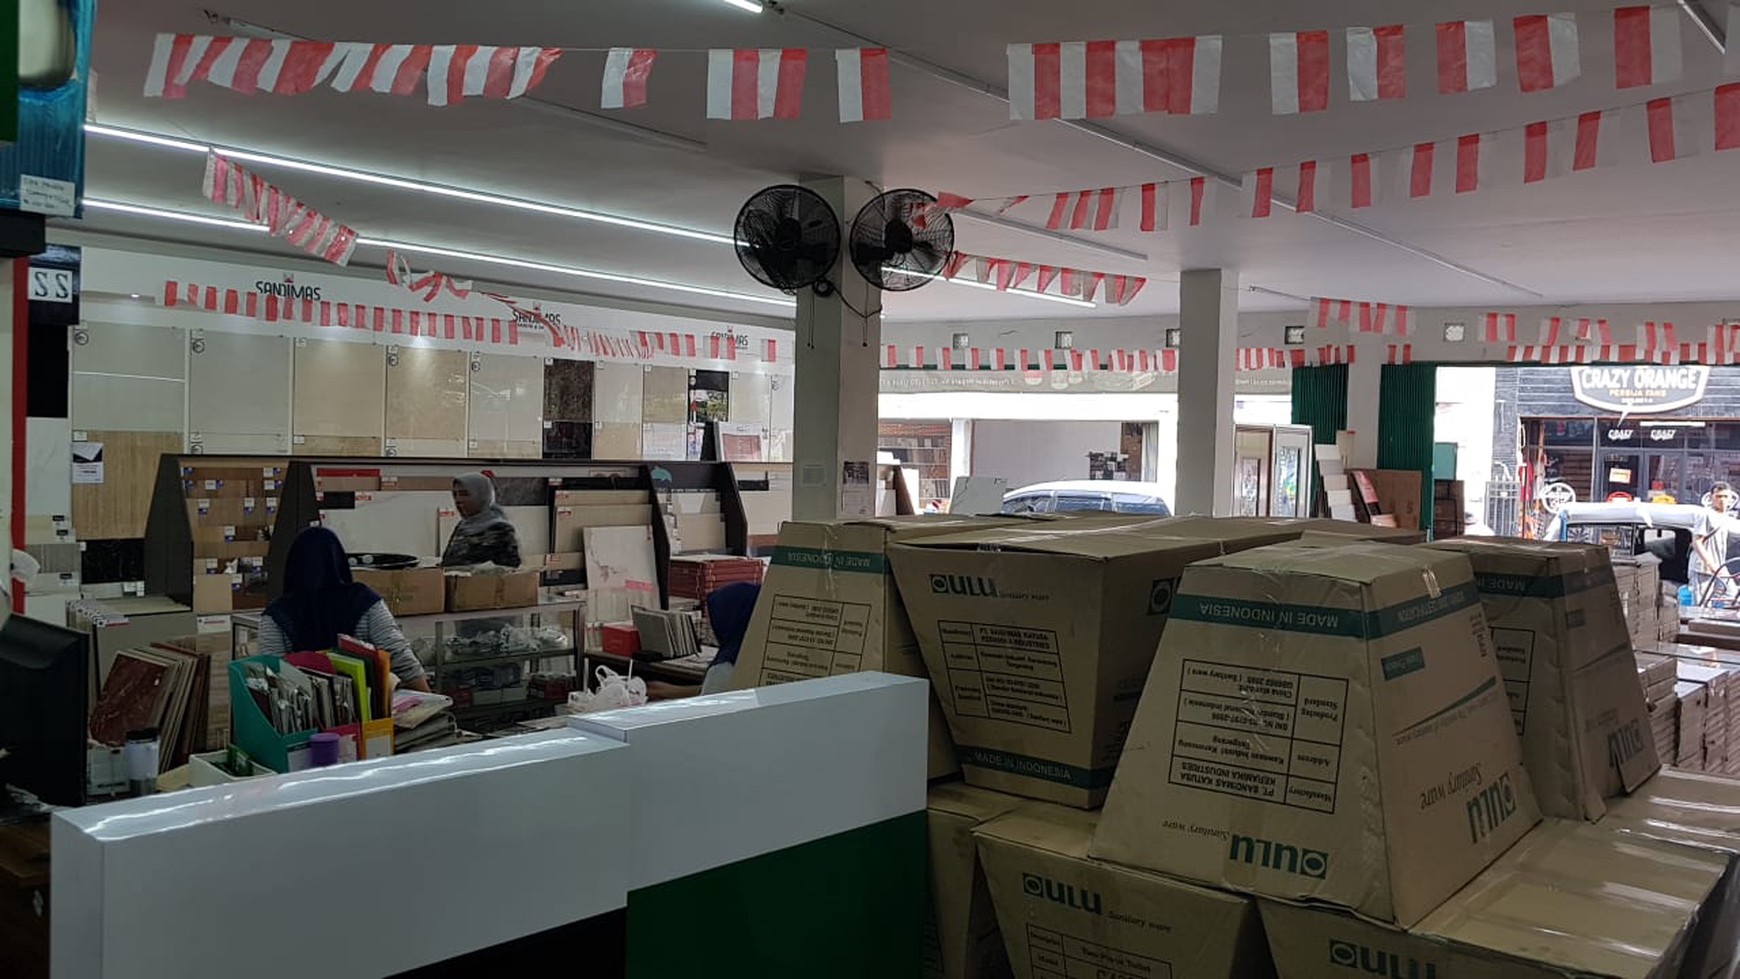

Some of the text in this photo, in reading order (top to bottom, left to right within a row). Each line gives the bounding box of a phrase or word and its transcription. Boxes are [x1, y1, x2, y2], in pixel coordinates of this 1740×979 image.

[255, 280, 321, 301] SANDIMAS
[1581, 369, 1697, 389] CRAZY ORANGE
[1200, 603, 1339, 628] MADE IN INDONESIA
[1181, 761, 1231, 778] INDUSTRIES
[1162, 820, 1186, 831] ware
